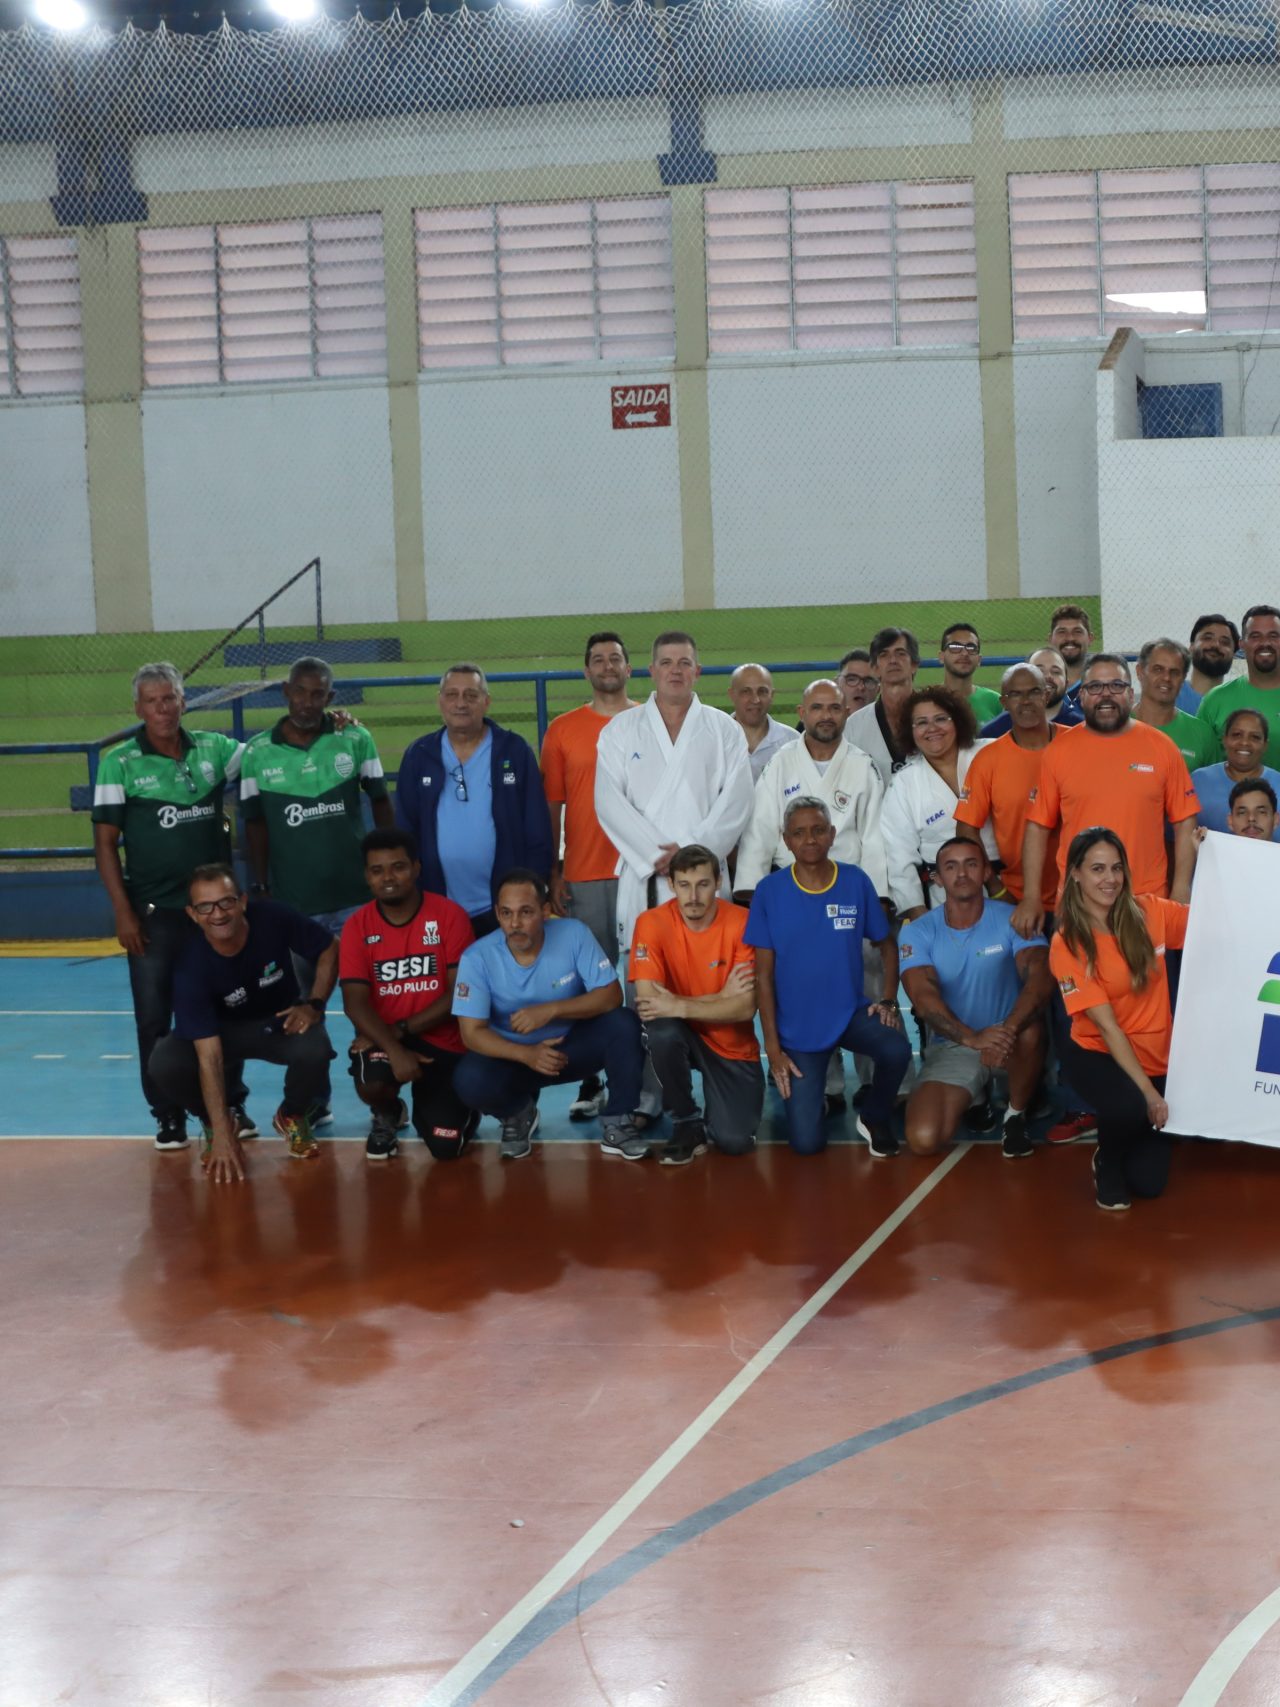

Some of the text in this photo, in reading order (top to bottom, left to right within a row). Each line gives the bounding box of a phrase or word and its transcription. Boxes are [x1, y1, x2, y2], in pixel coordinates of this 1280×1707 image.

[613, 388, 669, 407] SAIDA
[422, 934, 441, 946] SESI
[381, 955, 430, 982] SESI
[379, 979, 439, 997] SÃO PAULO
